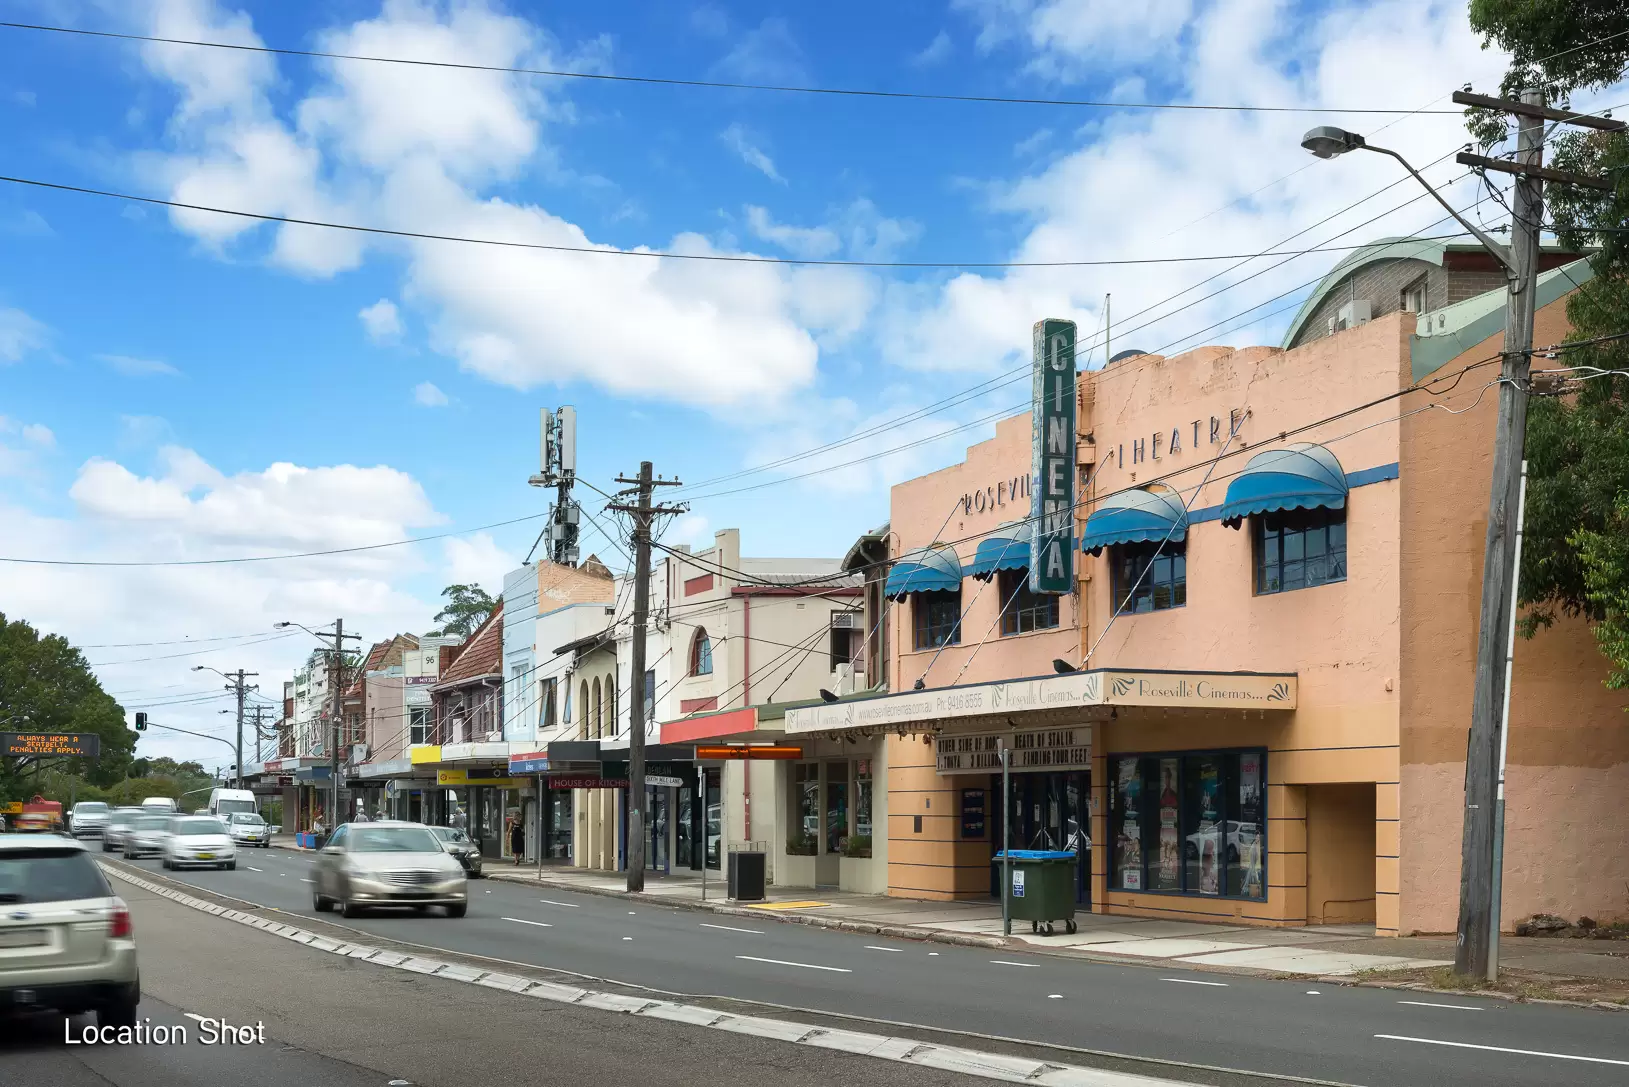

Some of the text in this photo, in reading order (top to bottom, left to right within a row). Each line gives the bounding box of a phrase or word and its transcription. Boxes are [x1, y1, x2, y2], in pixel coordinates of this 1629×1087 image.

[1044, 333, 1072, 579] CINEMA
[425, 656, 435, 665] 96
[1139, 679, 1263, 700] Roseville Cinemas...
[947, 695, 964, 710] 9416
[965, 693, 982, 708] 8555
[938, 736, 1000, 753] OTHER SIDE OF HOP
[1014, 731, 1074, 748] DEATH OF STALIN
[970, 754, 975, 767] 3
[976, 752, 1014, 767] BILLBOS
[1023, 748, 1088, 765] FINDING YOUR FEET
